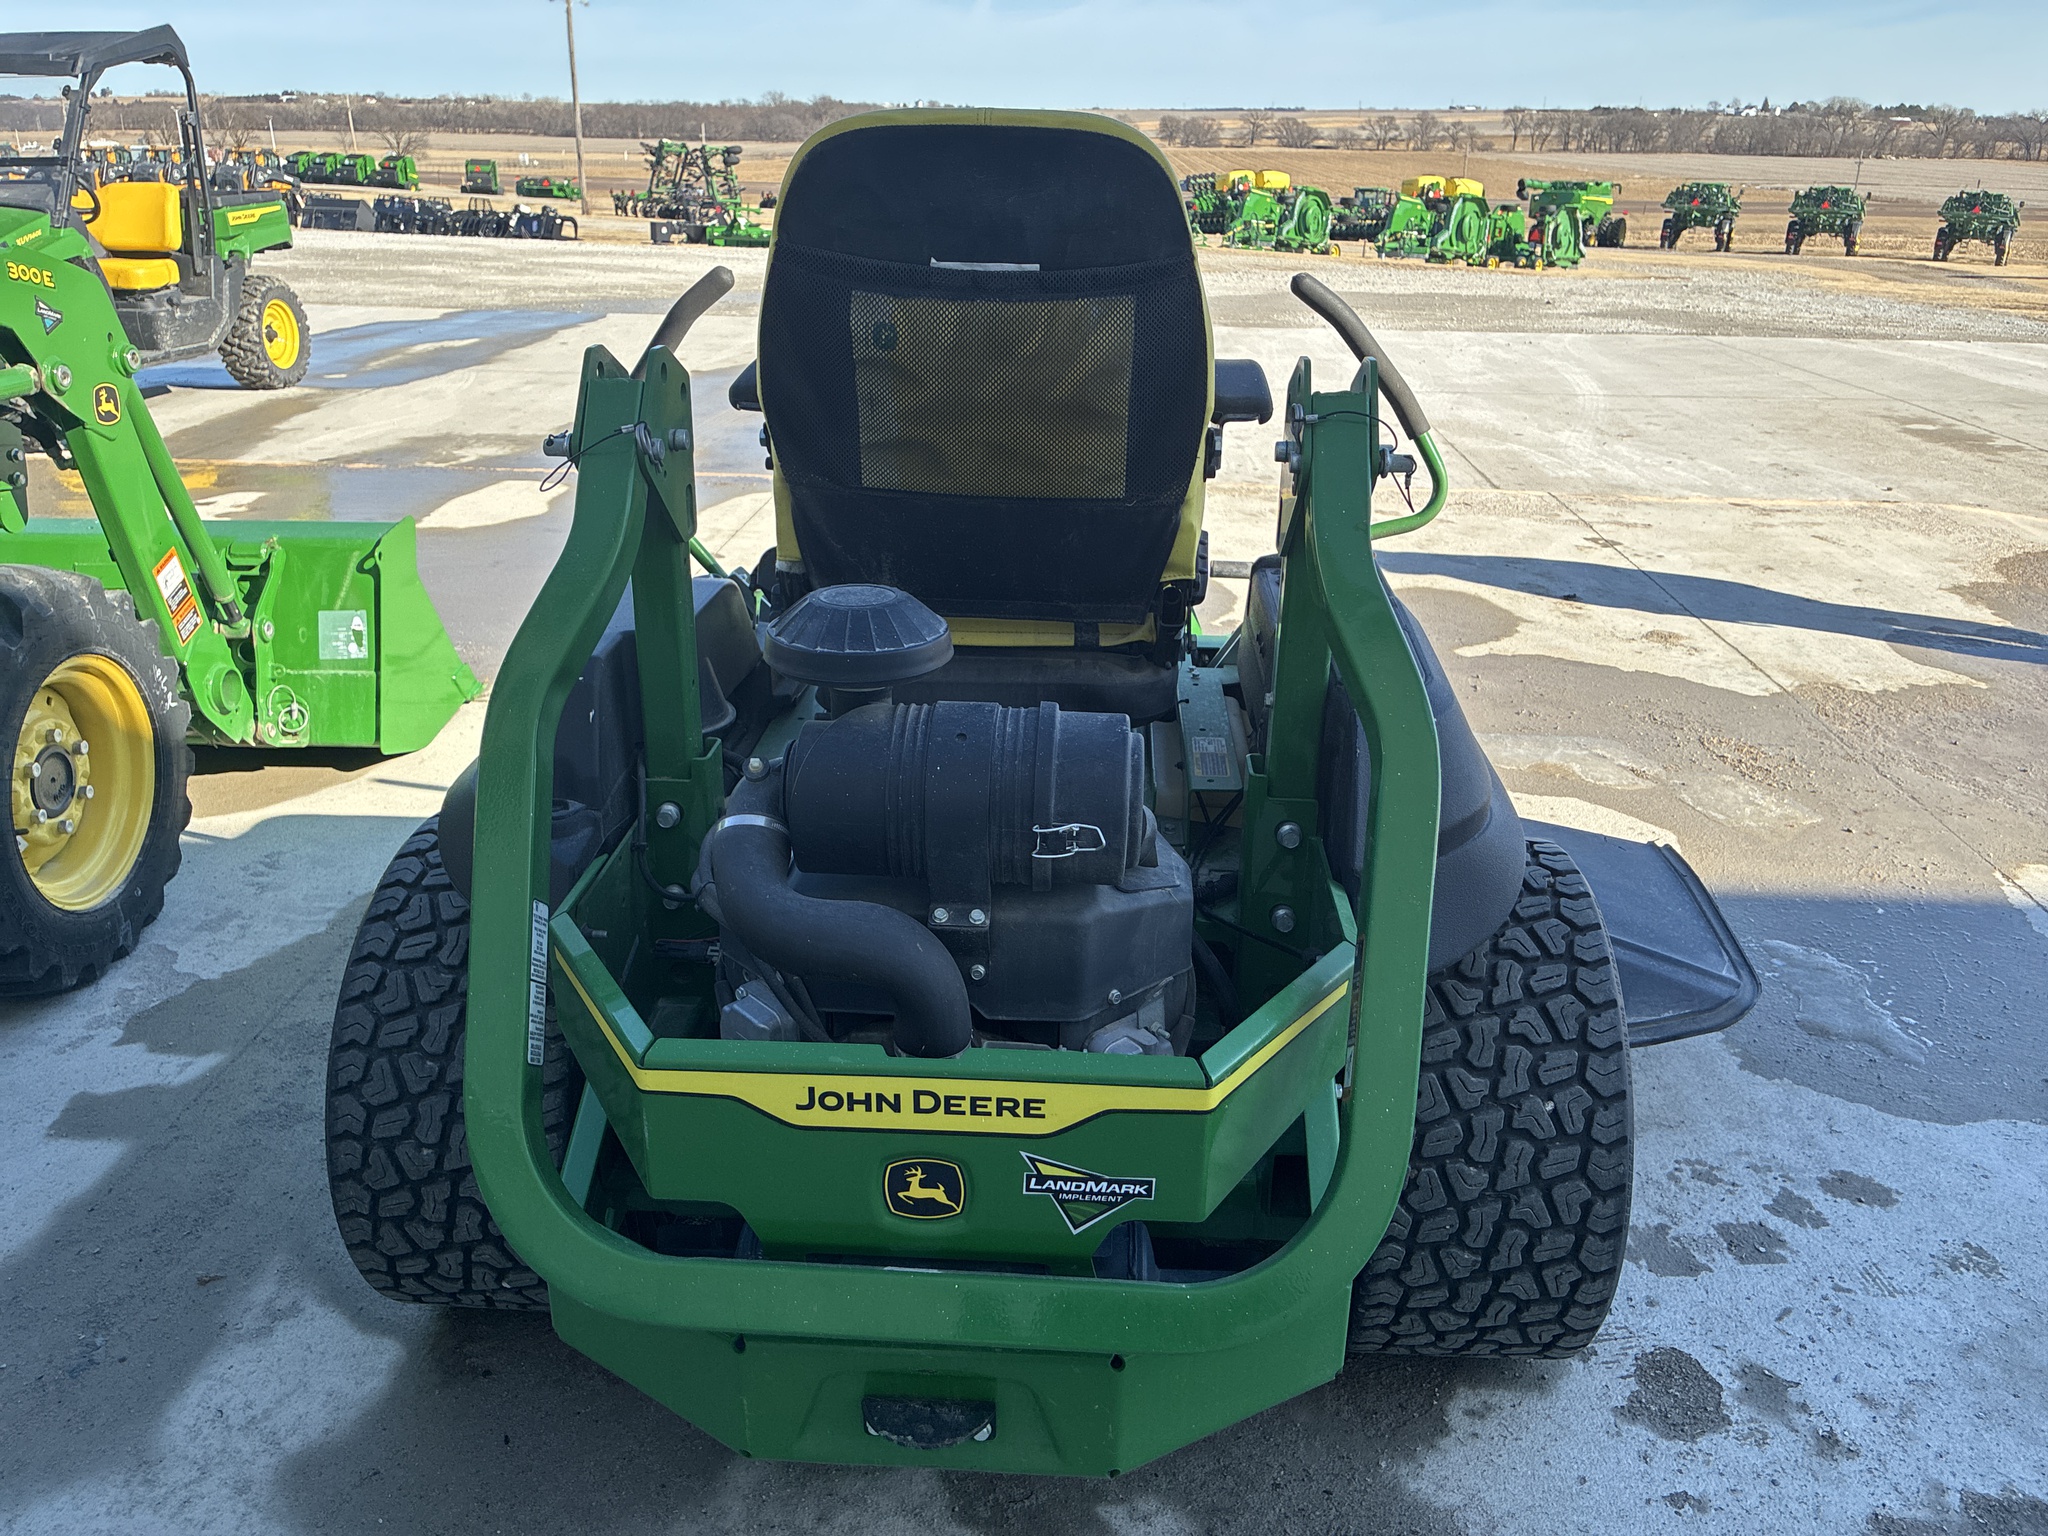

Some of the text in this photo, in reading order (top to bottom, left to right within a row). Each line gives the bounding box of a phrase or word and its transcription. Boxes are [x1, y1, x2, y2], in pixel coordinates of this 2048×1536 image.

[6, 261, 56, 289] 300E
[796, 1086, 1046, 1119] JOHN DEERE
[1029, 1177, 1149, 1195] LANDMARK
[1058, 1193, 1123, 1203] IMPLEMENT
